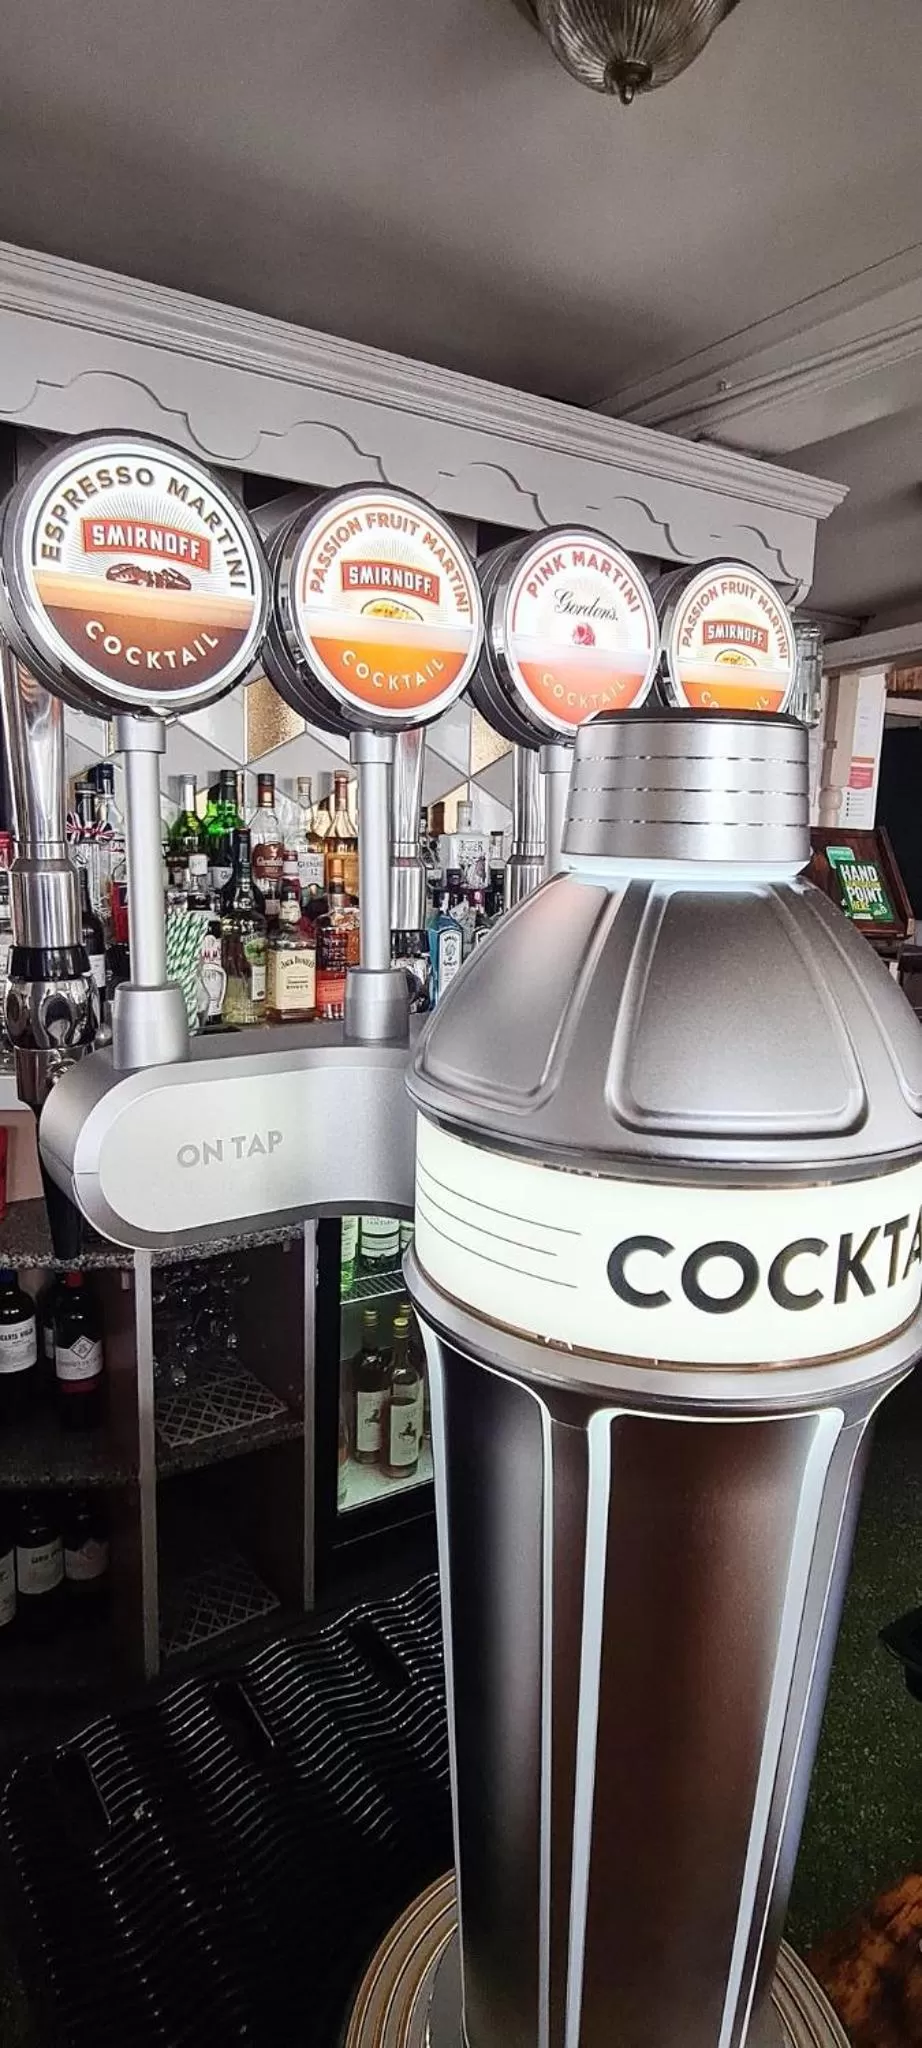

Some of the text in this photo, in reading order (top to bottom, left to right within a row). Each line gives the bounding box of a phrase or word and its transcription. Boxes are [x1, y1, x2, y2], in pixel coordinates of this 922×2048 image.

[41, 466, 246, 589] ESPRESSO MARTINI
[92, 523, 201, 562] SMIRNOFF
[309, 512, 469, 613] PASSION FRUIT MARTINI
[348, 565, 432, 595] SMIRNOFF
[527, 550, 642, 613] PINK MARTINI
[682, 581, 788, 659] PASSION FRUIT MARTINI
[706, 621, 765, 646] SMIRNOFF
[85, 620, 219, 670] COCKTAIL
[341, 649, 445, 691] COCKTAIL
[541, 672, 627, 710] COCKTAIL
[840, 864, 878, 882] HAND
[847, 887, 883, 905] POINT
[177, 1130, 283, 1168] ON TAP
